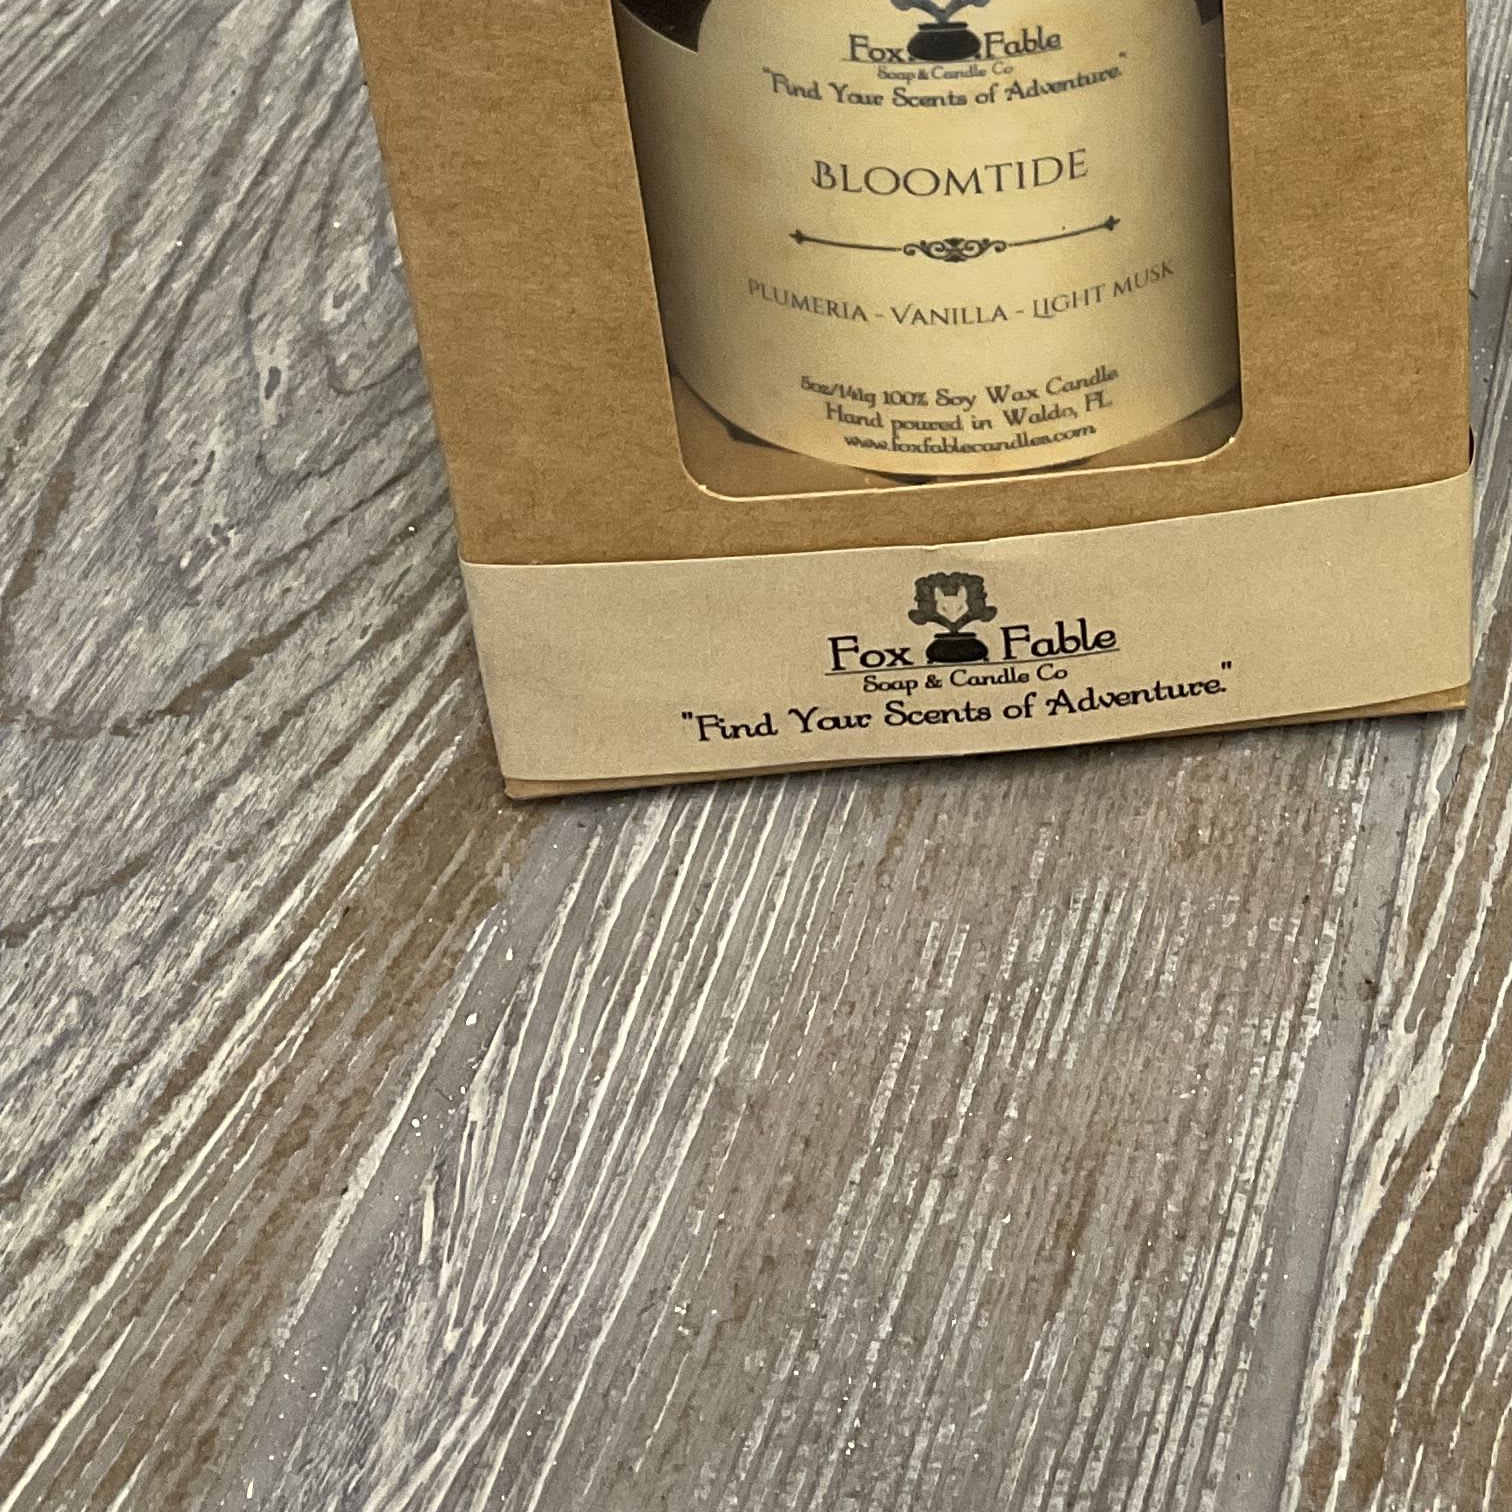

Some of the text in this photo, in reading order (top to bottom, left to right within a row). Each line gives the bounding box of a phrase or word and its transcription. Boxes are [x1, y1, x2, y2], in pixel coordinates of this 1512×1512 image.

[848, 26, 1062, 62] Fox Fable
[878, 61, 1014, 82] Soap & Candle Co
[827, 82, 884, 106] Your
[892, 87, 967, 107] Scents
[975, 84, 996, 106] of
[812, 148, 1088, 196] BLOOMTIDE
[748, 276, 868, 322] PLUMERIA
[891, 303, 1008, 325] VANILLA
[1112, 259, 1175, 298] MUSK
[883, 389, 929, 407] 100%
[935, 388, 977, 411] Soy
[984, 385, 1040, 405] Wax
[1046, 365, 1119, 396] Candle
[825, 402, 883, 428] Hand
[890, 414, 962, 436] poured
[971, 414, 993, 431] in
[1004, 403, 1078, 428] Waldo,
[843, 423, 1096, 454] www.foxfablecandles.com
[828, 618, 1118, 671] Fox Fable
[863, 663, 1068, 696] Soap & Candle Co
[682, 711, 779, 742] "Find
[787, 706, 872, 734] Your
[884, 700, 991, 727] Scents
[1002, 692, 1038, 719] of
